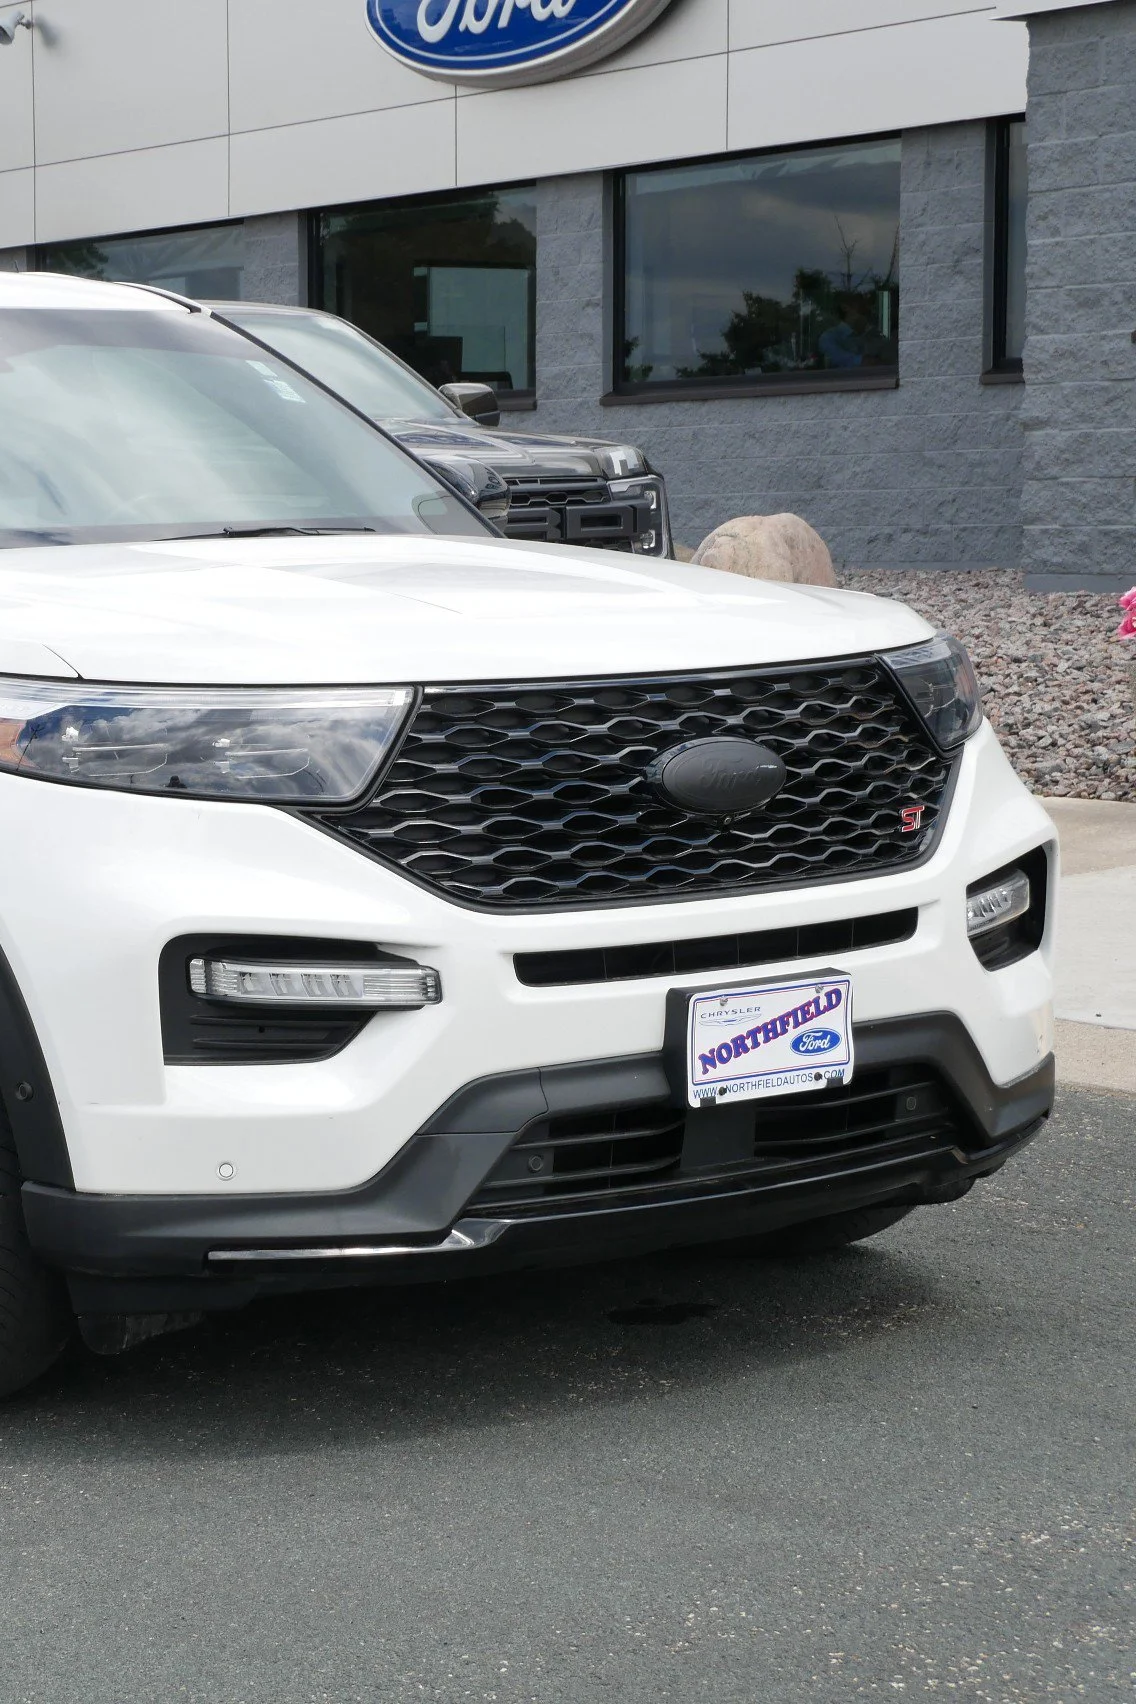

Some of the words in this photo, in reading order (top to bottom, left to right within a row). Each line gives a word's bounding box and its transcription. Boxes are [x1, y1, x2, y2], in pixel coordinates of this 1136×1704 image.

[901, 805, 925, 832] ST
[700, 1006, 761, 1019] CHRYSLER
[698, 988, 843, 1075] NORTHFIELD
[799, 1031, 831, 1051] Ford
[693, 1069, 845, 1099] WWW.NORTHFIELDAUTOSCOM
